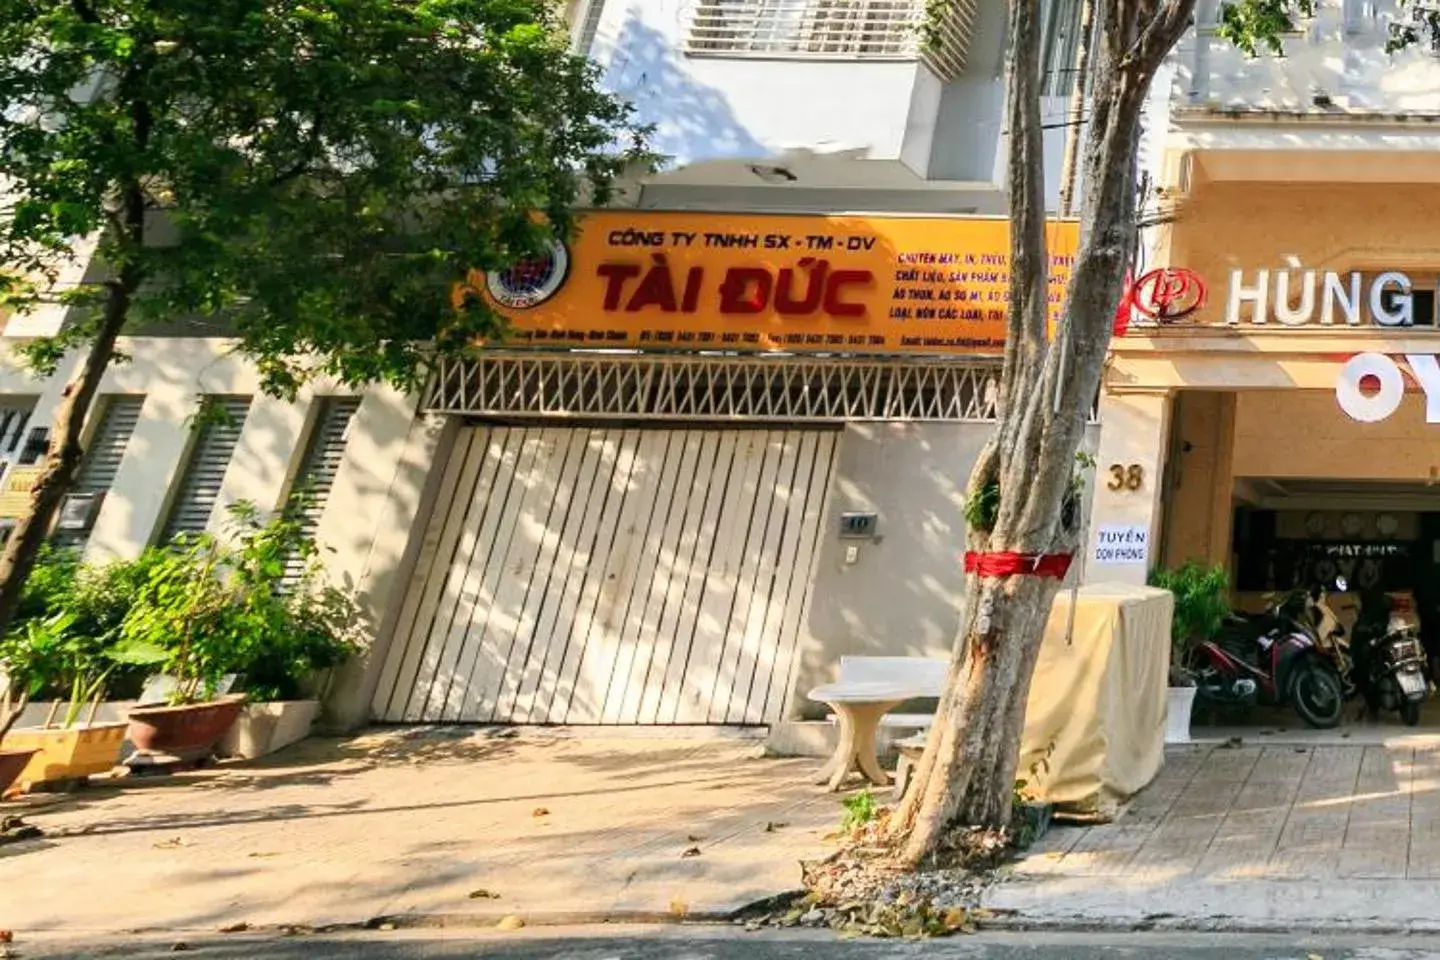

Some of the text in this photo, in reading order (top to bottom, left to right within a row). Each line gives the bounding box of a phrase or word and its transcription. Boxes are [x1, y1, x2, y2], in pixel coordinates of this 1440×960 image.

[608, 231, 663, 246] CÔNG
[671, 233, 696, 246] TY
[703, 233, 757, 248] TNHH
[764, 234, 791, 249] SX
[805, 236, 833, 250] TM
[847, 237, 875, 250] DV
[597, 253, 873, 316] TÀI ĐỨC
[1228, 256, 1415, 326] HÙNG
[1107, 464, 1143, 491] 38
